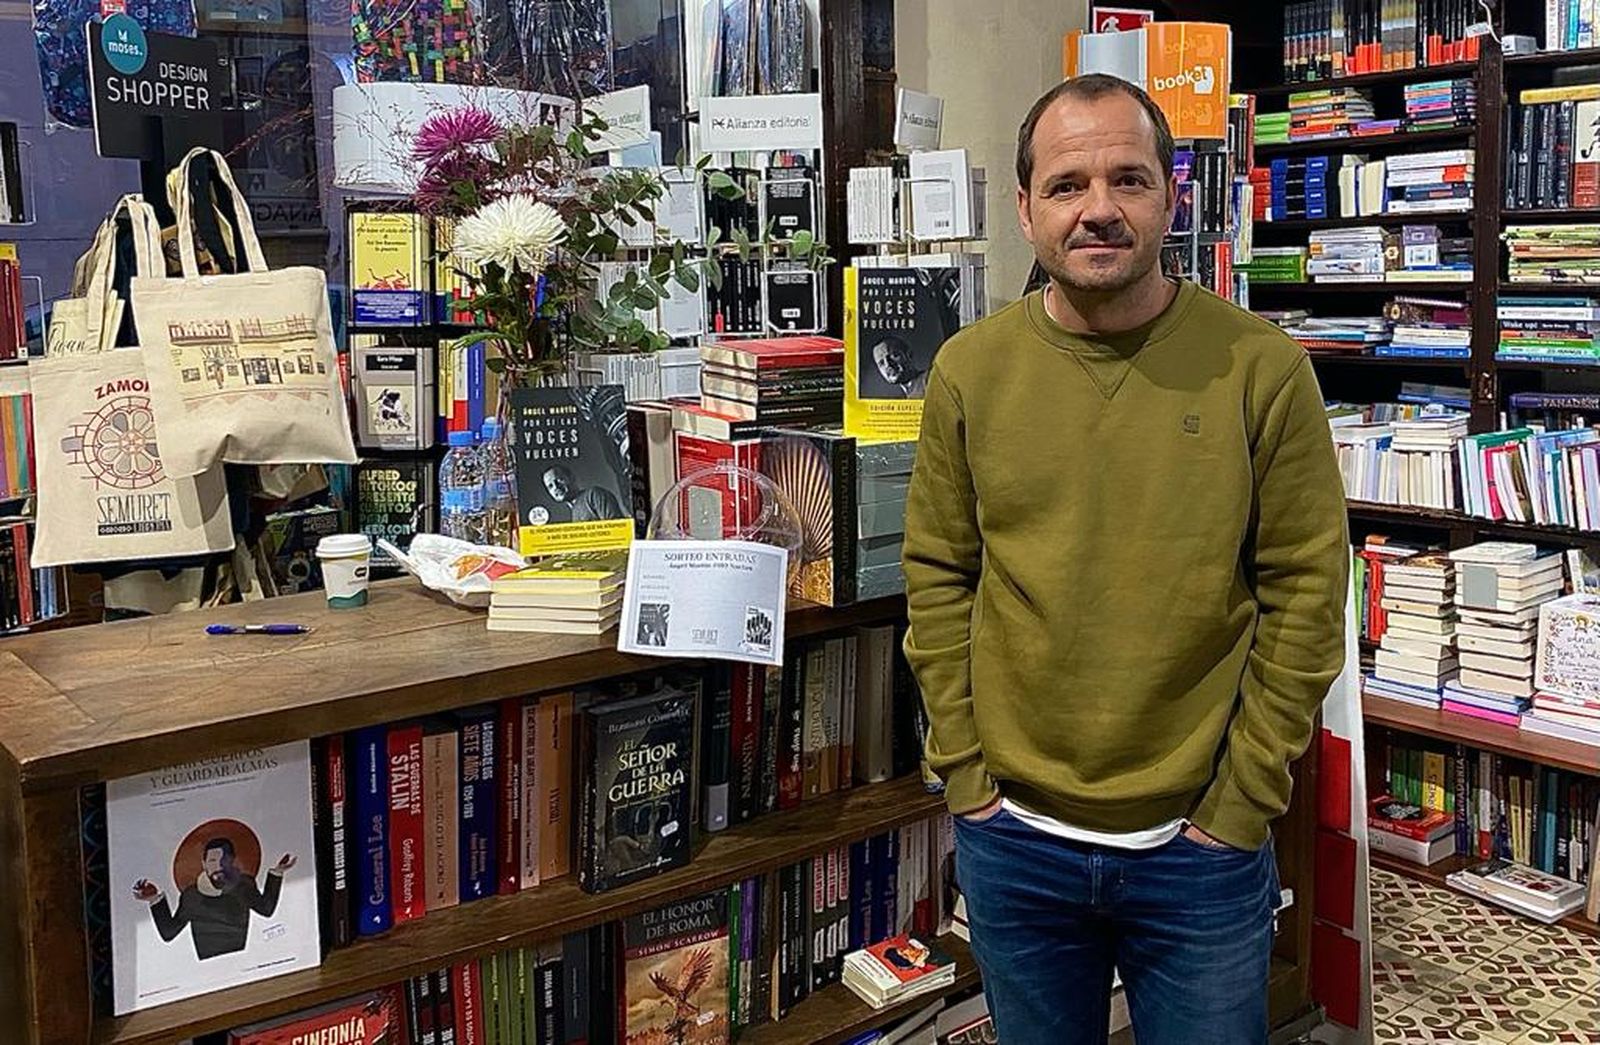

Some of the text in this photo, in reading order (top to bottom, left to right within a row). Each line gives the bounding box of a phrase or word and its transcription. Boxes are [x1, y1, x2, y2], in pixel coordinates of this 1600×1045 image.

[108, 41, 143, 56] moses.
[159, 62, 208, 83] DESIGN
[106, 77, 210, 111] SHOPPER
[726, 115, 812, 130] Alianza editorial
[862, 301, 915, 315] VOCES
[862, 319, 915, 329] VUELVEN
[897, 402, 923, 411] ESPECIA
[524, 429, 578, 445] VOCES
[524, 447, 579, 460] VUELVEN
[359, 469, 401, 480] ALFRED
[97, 493, 171, 525] SEMURET
[360, 523, 411, 535] LEER CON
[664, 552, 757, 564] SORTEO ENTRADAS
[464, 725, 477, 754] SIETE
[624, 740, 637, 751] EL
[464, 755, 482, 782] AÑOS
[618, 742, 677, 771] SEÑOR
[149, 776, 158, 788] Y
[162, 765, 230, 788] GUARDAR
[232, 758, 279, 776] ALMAS
[391, 755, 409, 811] STALIN
[409, 743, 421, 815] LAS GUERRAS DE
[632, 763, 666, 779] DE LA
[608, 769, 685, 801] GUERRA
[368, 814, 383, 842] Lee
[368, 845, 384, 905] General
[401, 837, 414, 903] Geoffrey Roberts
[643, 898, 715, 925] EL HONOR
[884, 898, 895, 937] eneral
[646, 914, 712, 940] DE ROMA
[638, 930, 720, 957] SIMON SCARROW
[292, 1016, 366, 1045] SINFONÍA
